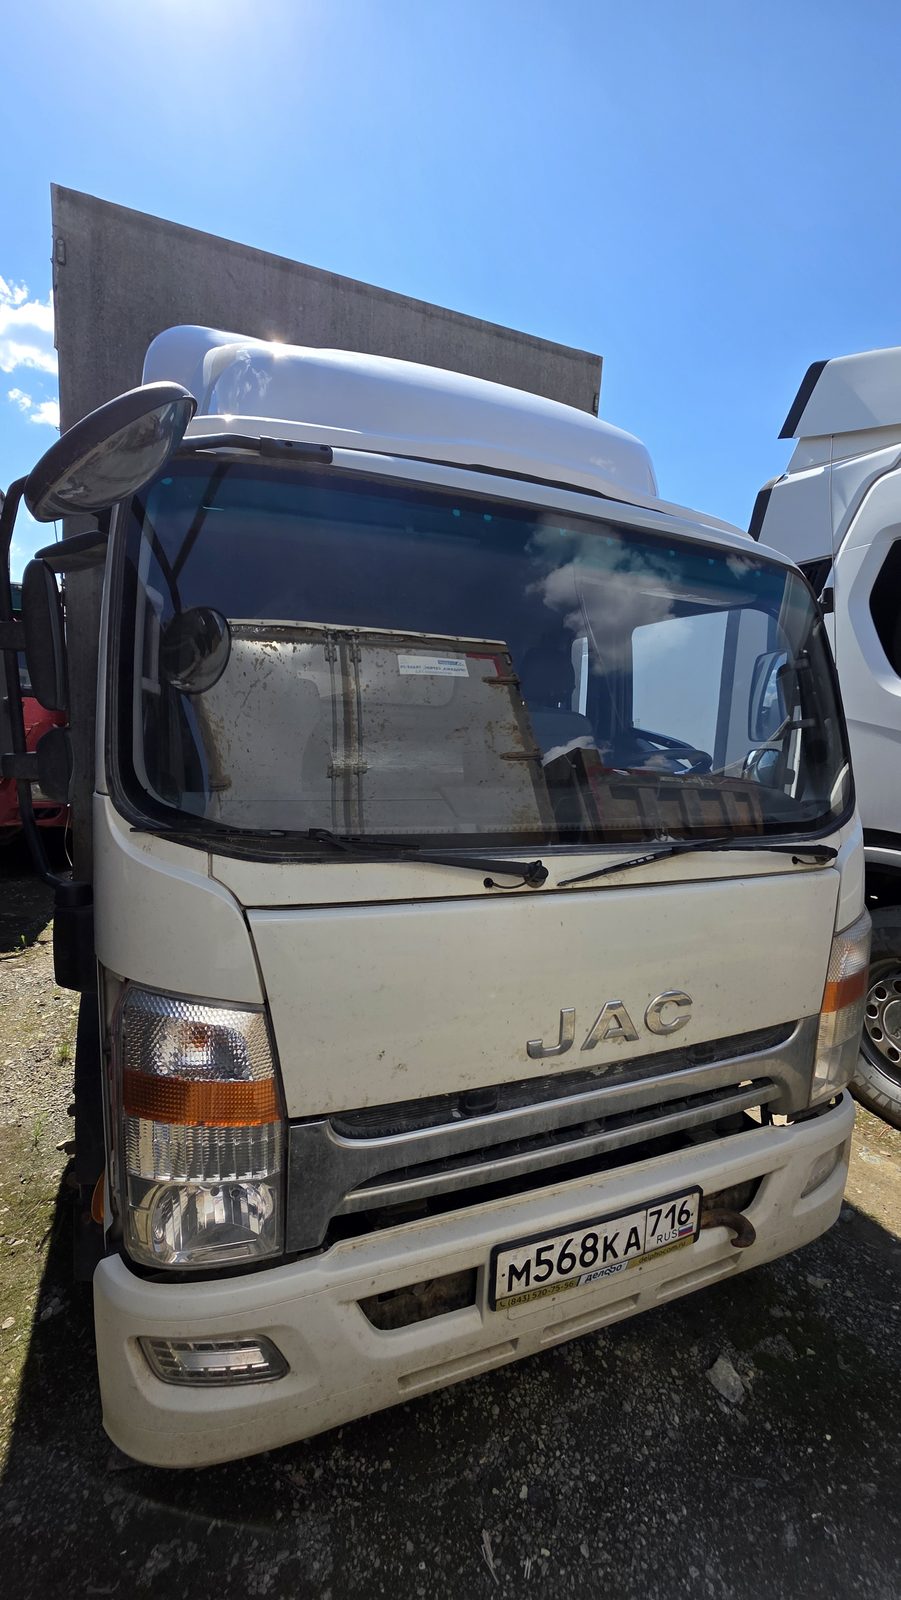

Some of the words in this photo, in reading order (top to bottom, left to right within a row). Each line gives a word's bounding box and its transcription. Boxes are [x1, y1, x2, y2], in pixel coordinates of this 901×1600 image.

[526, 989, 693, 1060] JAC
[649, 1200, 691, 1238] 716
[656, 1228, 678, 1245] RUS
